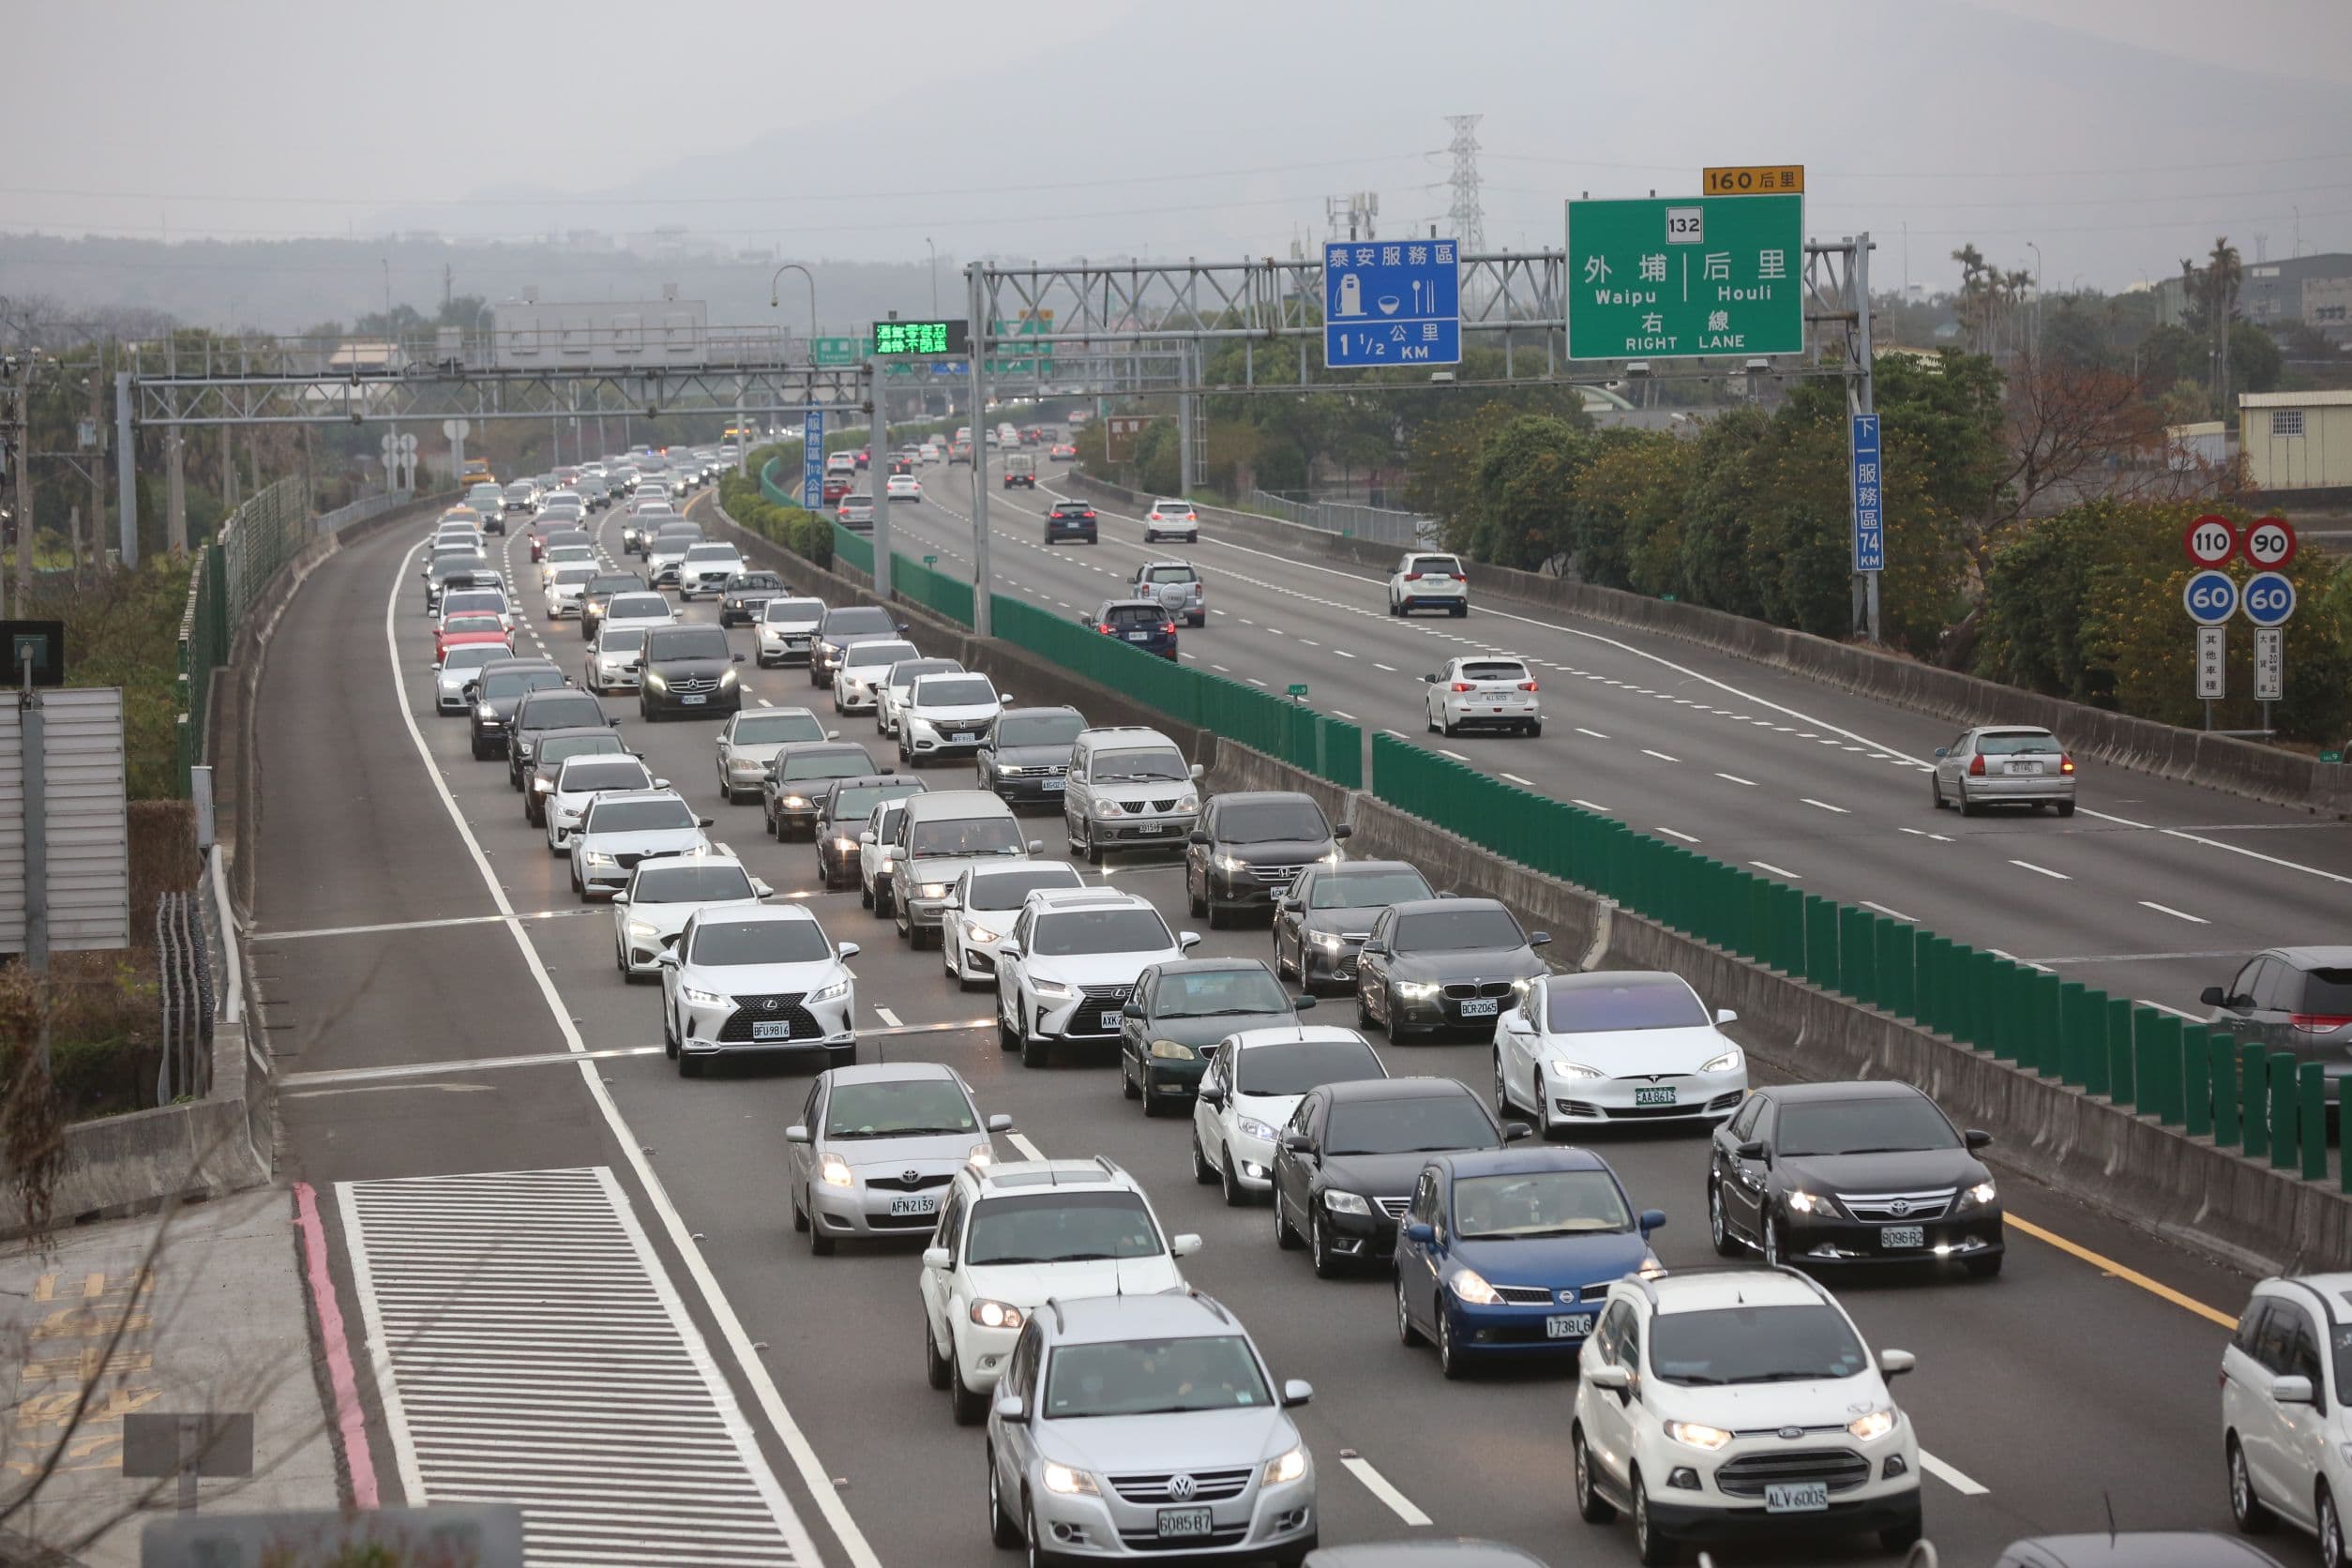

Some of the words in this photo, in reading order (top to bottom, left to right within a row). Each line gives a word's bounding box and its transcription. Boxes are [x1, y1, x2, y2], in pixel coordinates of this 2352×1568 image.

[1711, 172, 1752, 189] 160
[1759, 171, 1795, 188] 后里
[1669, 219, 1700, 233] 132
[1330, 244, 1454, 267] 泰安服務區
[1584, 253, 1667, 283] 外埔
[1703, 249, 1787, 280] 后里
[1595, 290, 1656, 307] Waipu
[1718, 284, 1772, 301] Houli
[1642, 309, 1728, 333] 右線
[1390, 323, 1439, 342] 公里
[1402, 345, 1428, 359] KM
[1626, 337, 1677, 351] RIGHT
[1699, 335, 1745, 349] LANE
[1856, 417, 1878, 529] 下一服務區
[1860, 533, 1879, 552] 74
[2196, 533, 2227, 550] 110
[2254, 535, 2285, 553] 90
[1861, 555, 1879, 566] KM
[2193, 587, 2229, 608] 60
[2251, 589, 2287, 610] 60
[2206, 635, 2217, 690] 其他車種
[1462, 1003, 1497, 1015] BCR-2065
